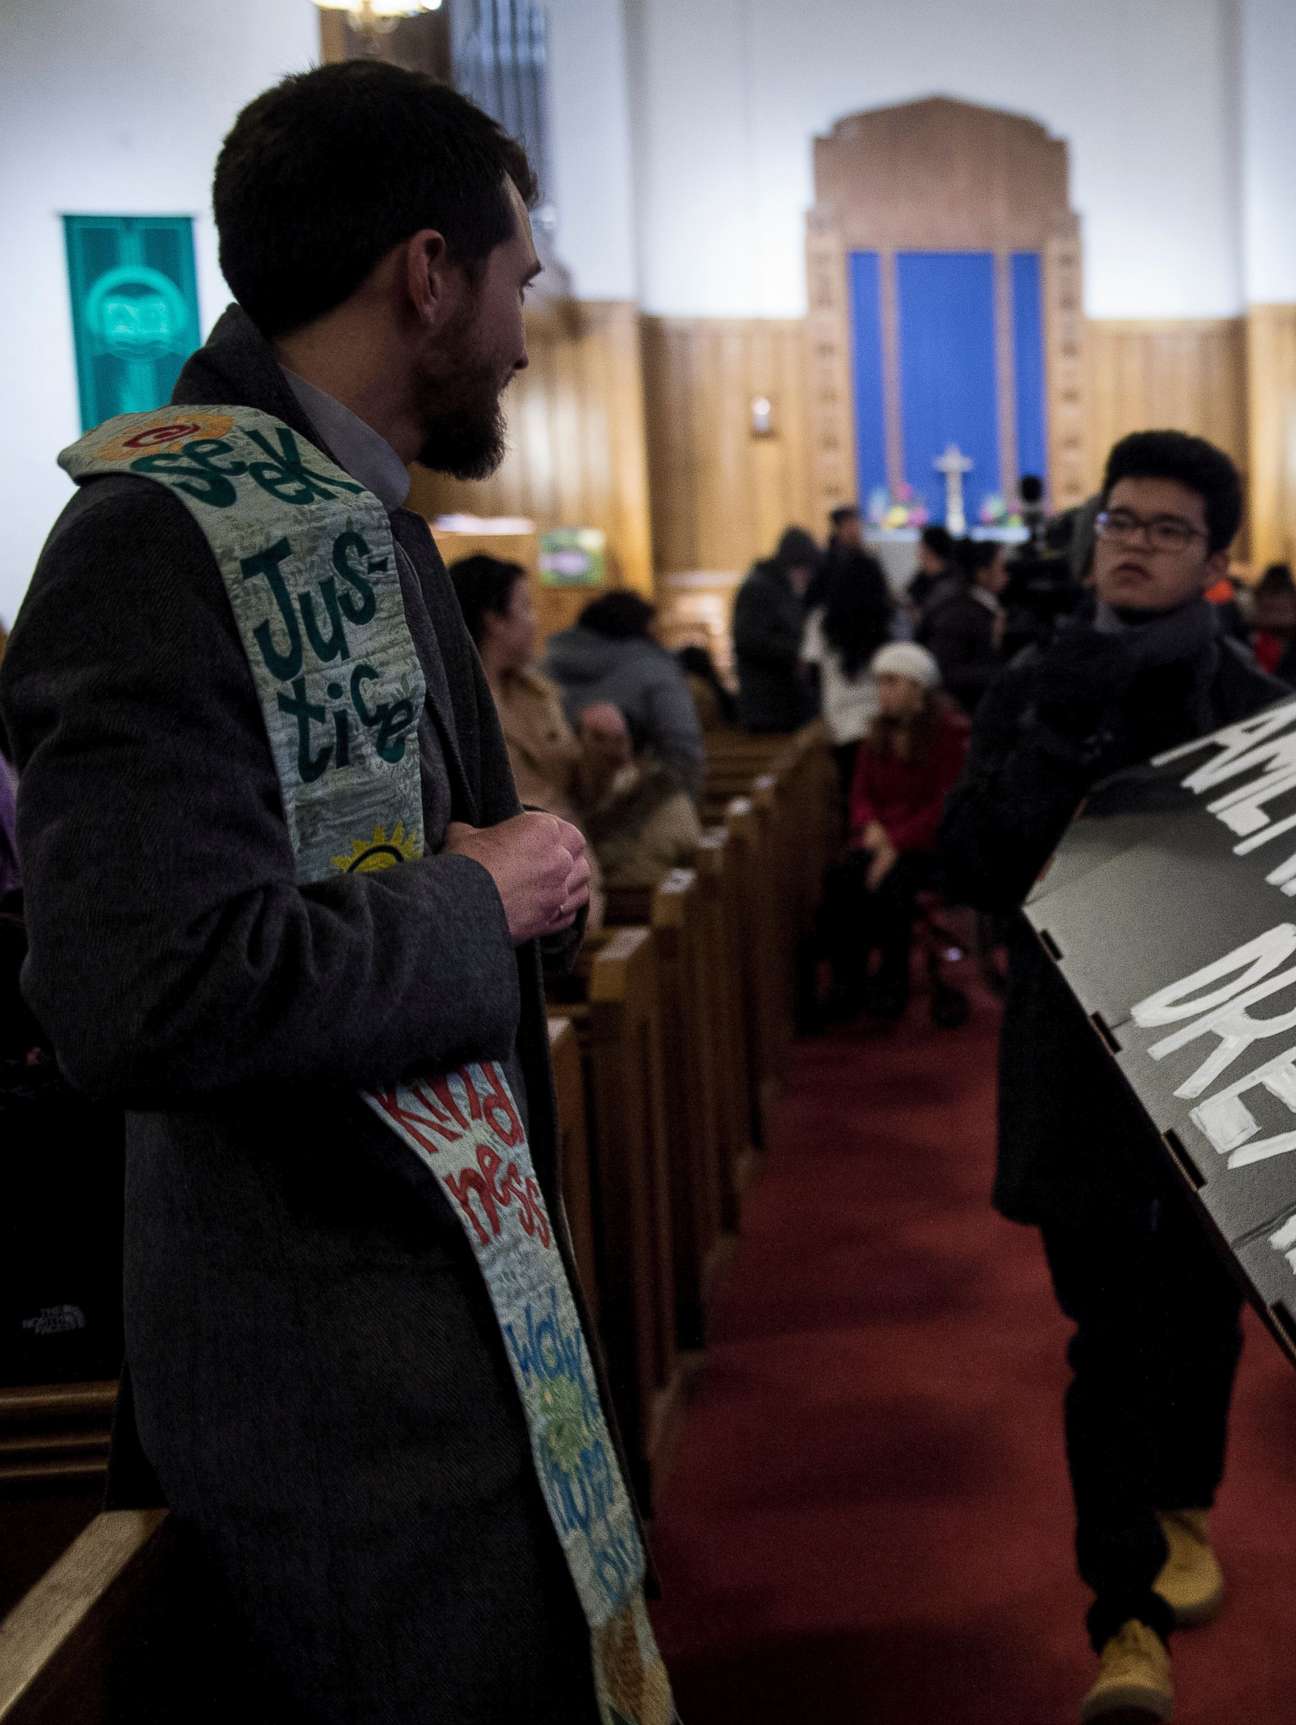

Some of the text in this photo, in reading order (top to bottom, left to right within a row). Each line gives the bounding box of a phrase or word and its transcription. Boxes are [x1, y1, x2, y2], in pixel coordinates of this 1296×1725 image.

[240, 531, 389, 682] Jus-
[278, 663, 416, 783] tice
[442, 1144, 551, 1249] ness
